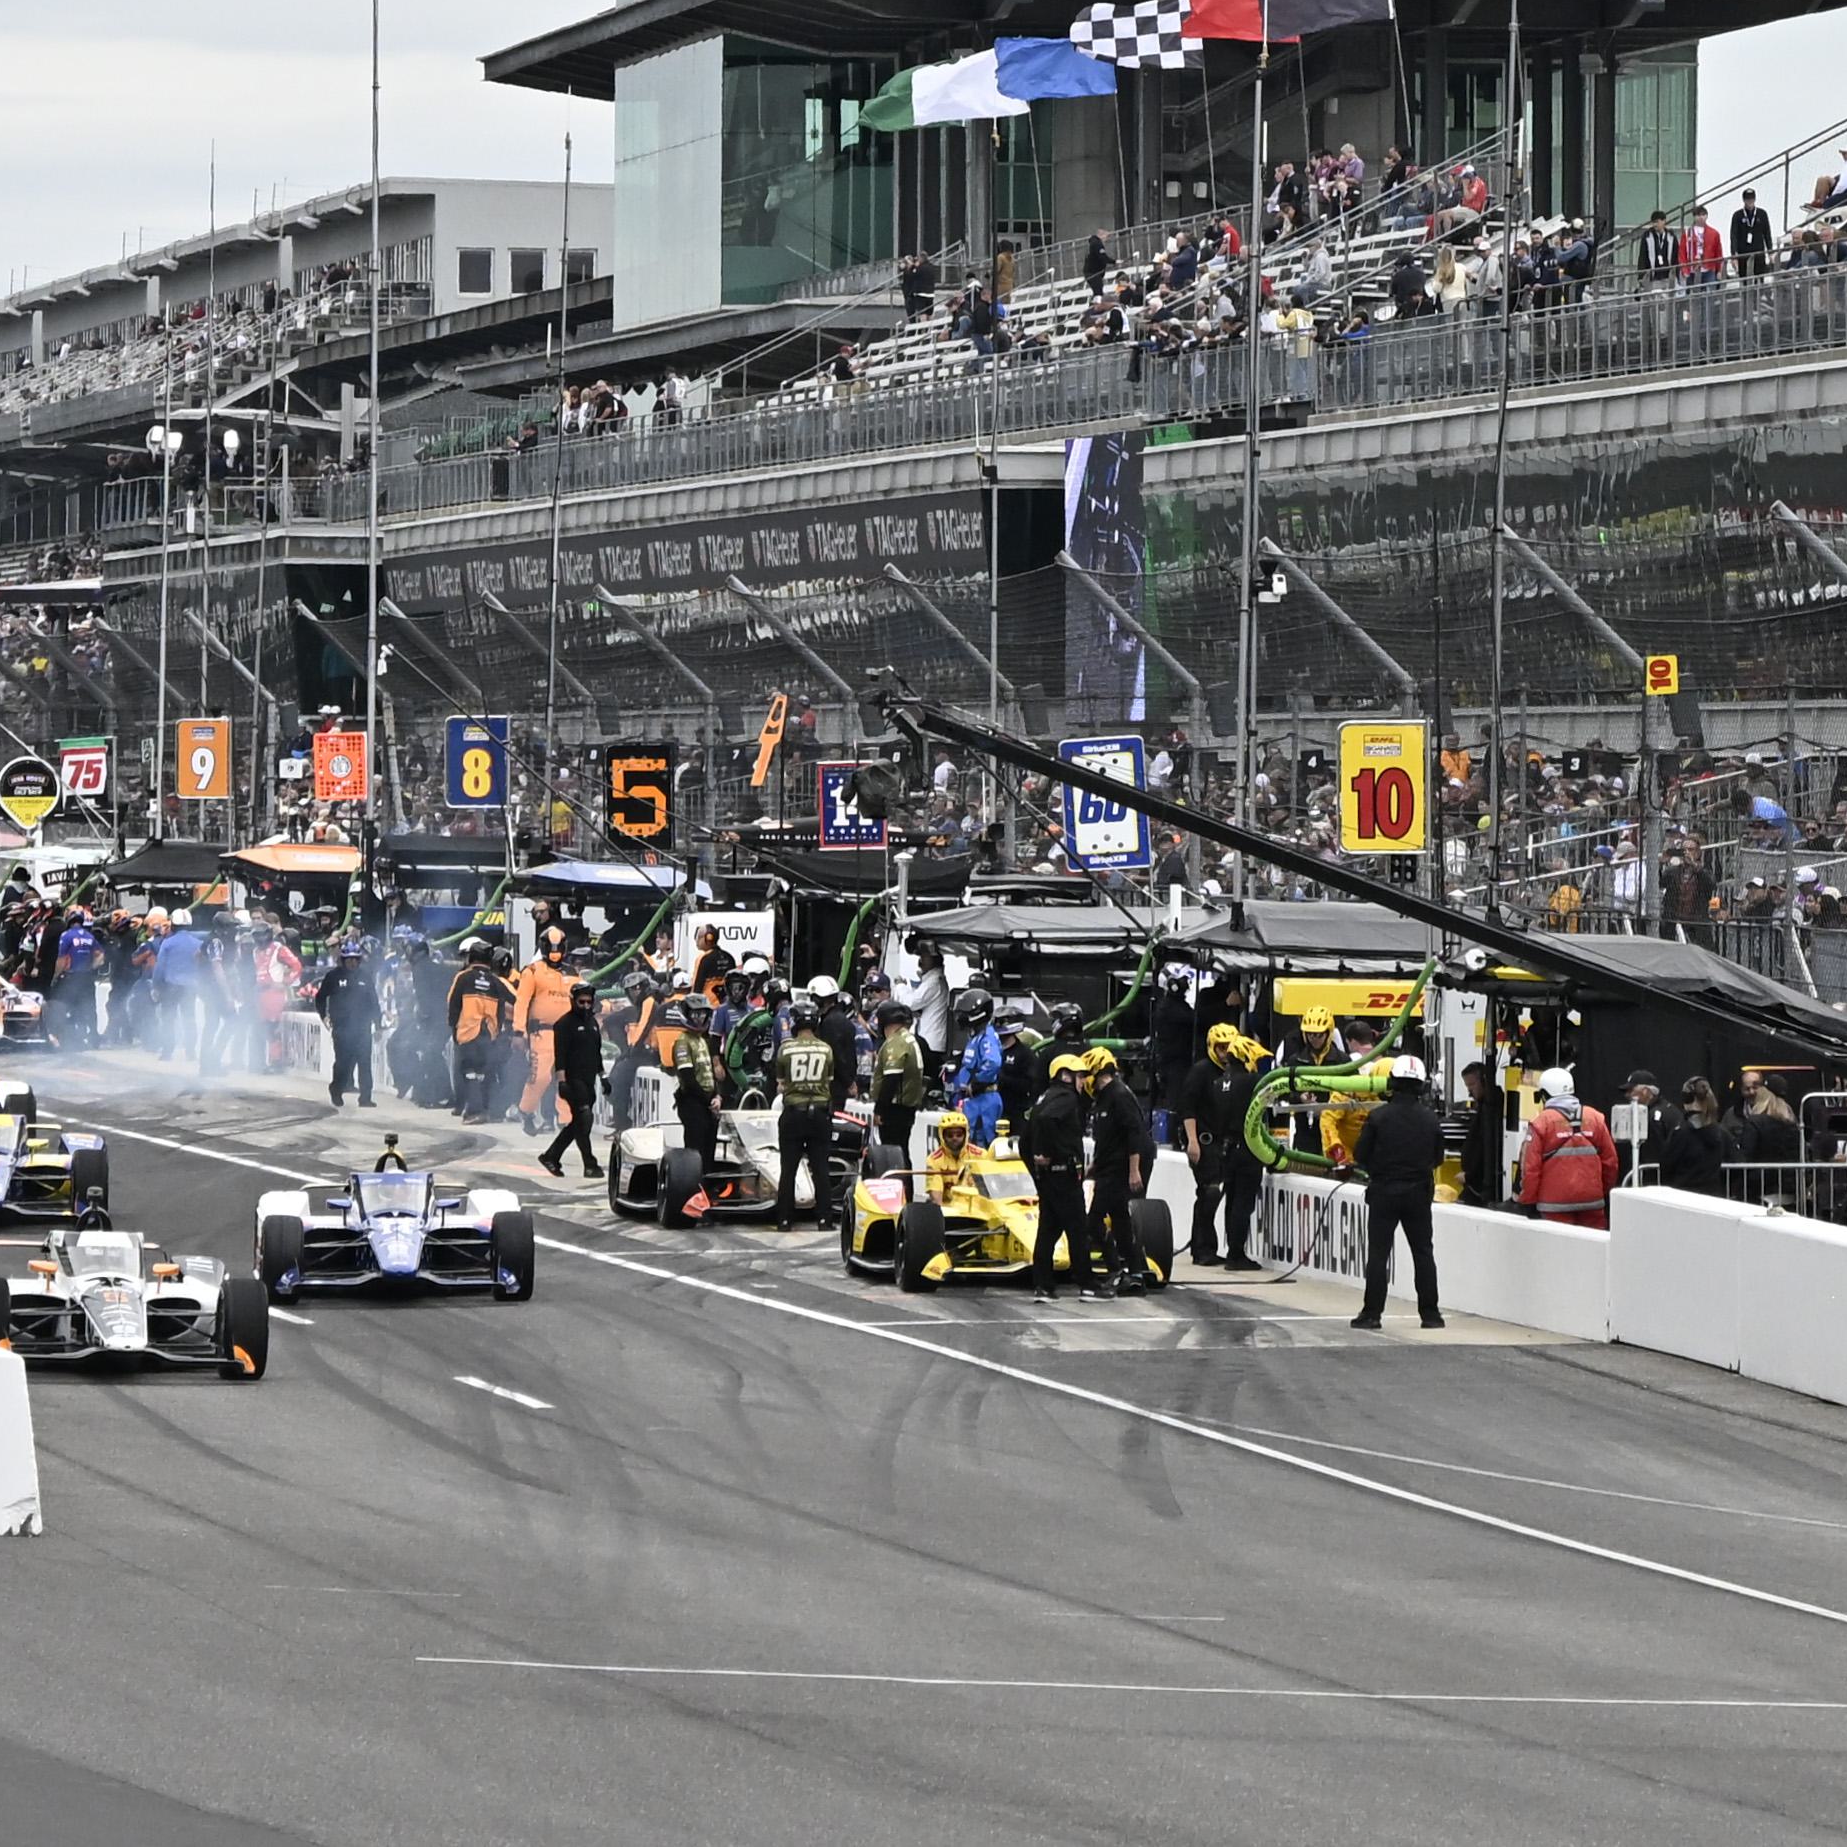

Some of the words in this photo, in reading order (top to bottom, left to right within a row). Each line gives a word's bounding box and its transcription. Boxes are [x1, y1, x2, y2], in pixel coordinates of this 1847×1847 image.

[1650, 659, 1672, 691] 10
[68, 759, 102, 789] 75
[191, 747, 215, 790] 9
[462, 748, 492, 798] 8
[1307, 756, 1317, 768] 4
[1570, 758, 1581, 772] 3
[611, 758, 667, 836] 5
[1351, 767, 1415, 840] 10
[787, 1054, 826, 1082] 60
[1297, 1193, 1310, 1268] 10
[1313, 1195, 1338, 1274] DHL
